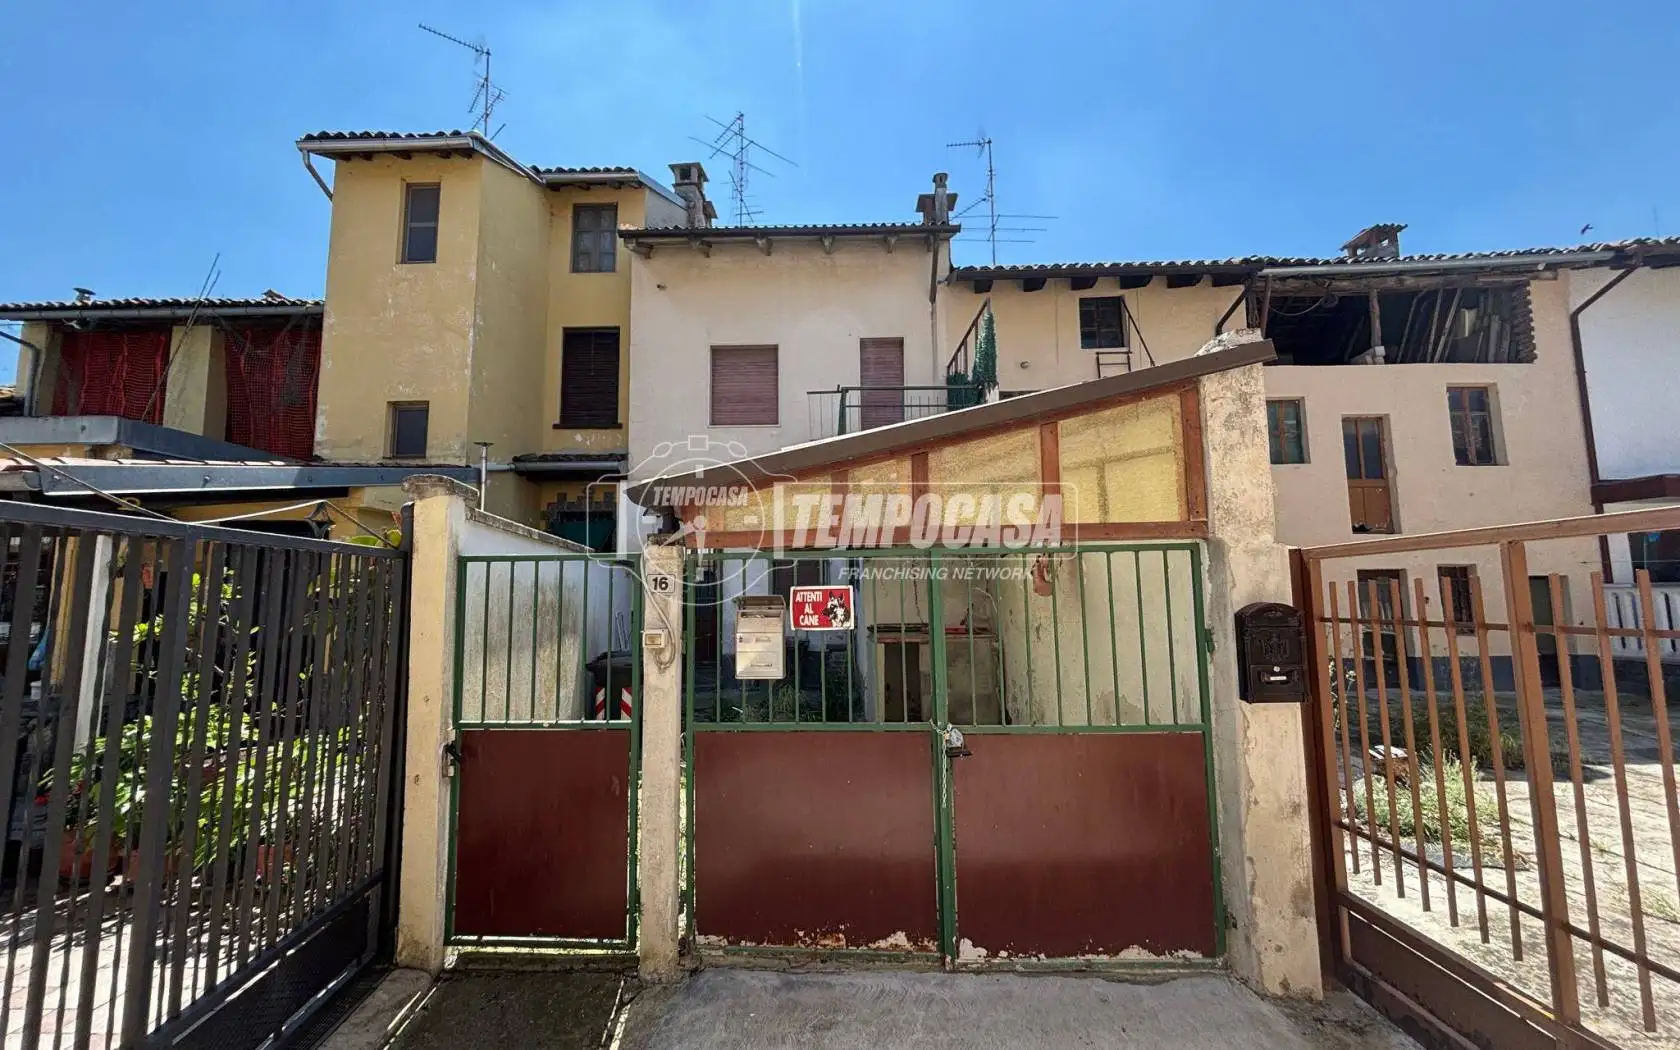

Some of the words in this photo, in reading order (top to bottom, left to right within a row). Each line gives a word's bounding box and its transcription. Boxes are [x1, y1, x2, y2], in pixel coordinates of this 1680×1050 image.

[652, 576, 669, 591] 16
[795, 591, 823, 602] ATTENTI
[804, 603, 814, 615] AL
[799, 615, 819, 626] CANE
